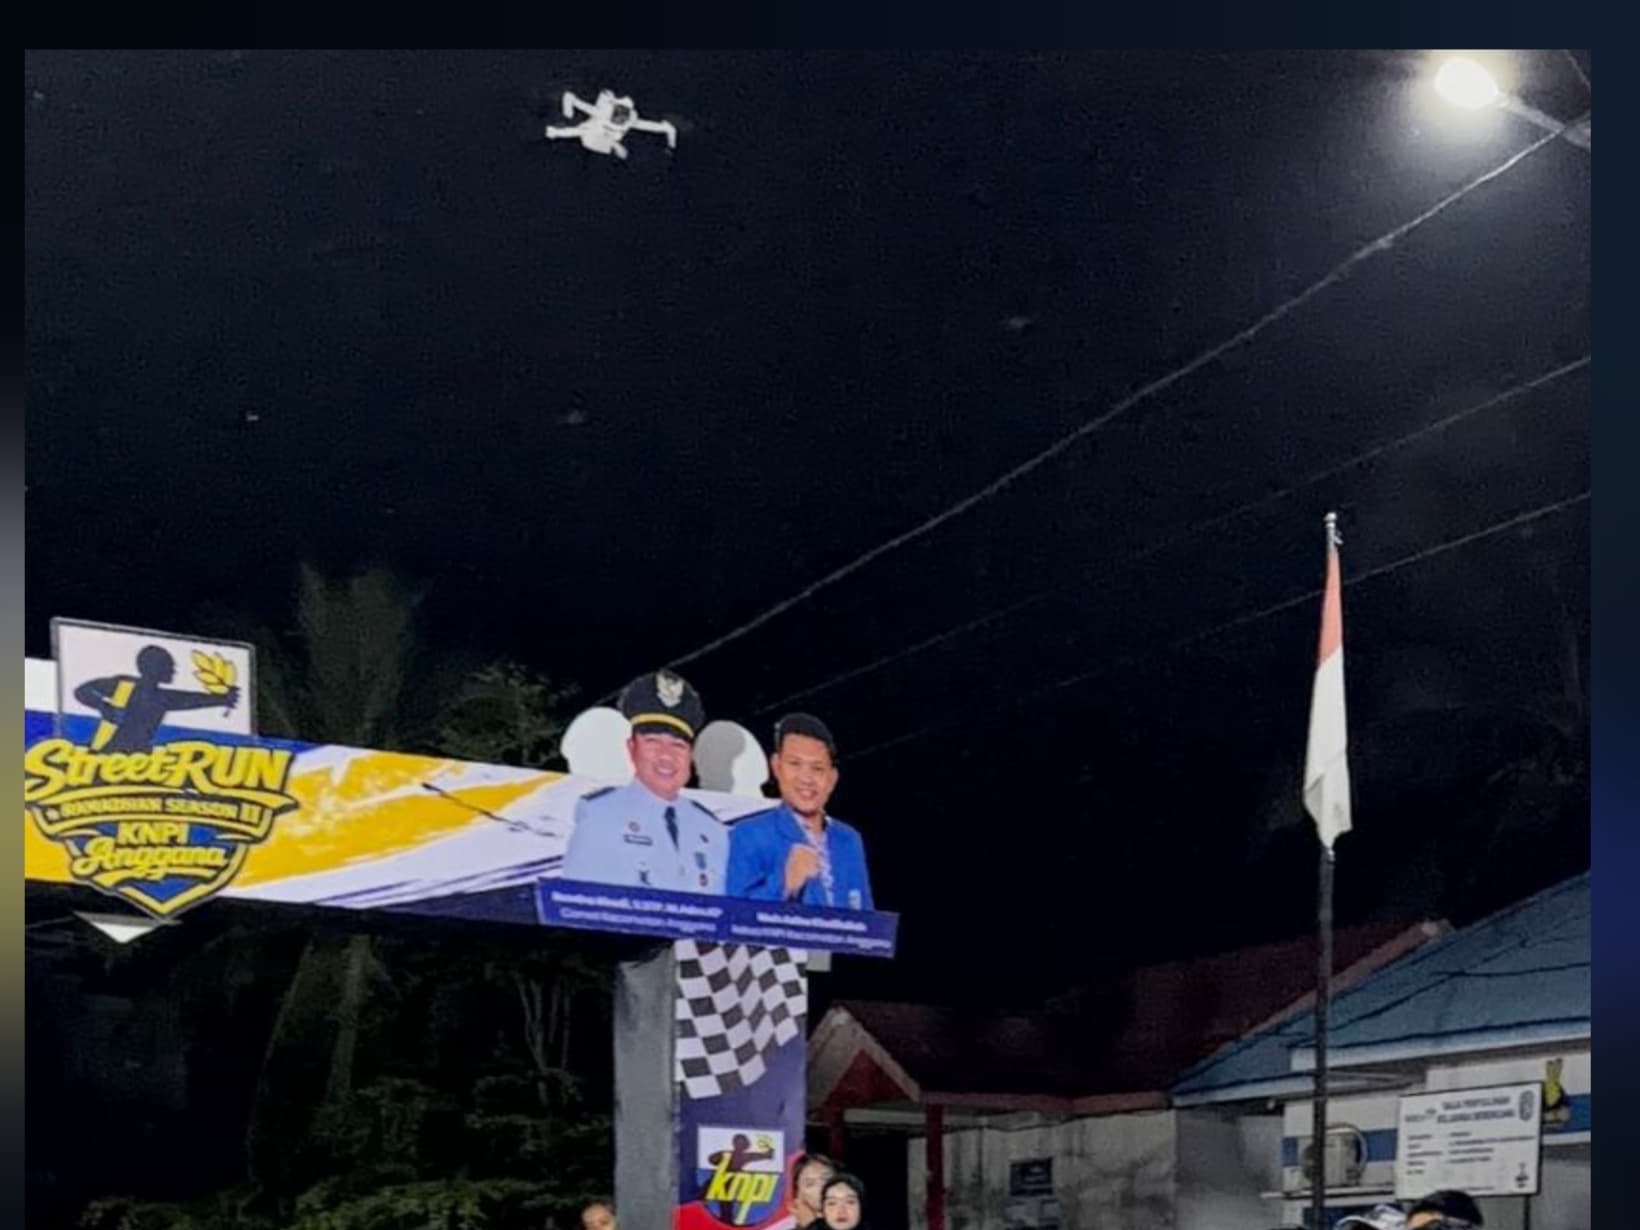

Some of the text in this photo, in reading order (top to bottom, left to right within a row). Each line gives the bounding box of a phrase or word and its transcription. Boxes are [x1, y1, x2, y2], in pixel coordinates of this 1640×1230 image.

[117, 821, 189, 846] KNPI
[72, 837, 226, 878] Anggana
[705, 1152, 780, 1227] knpi
